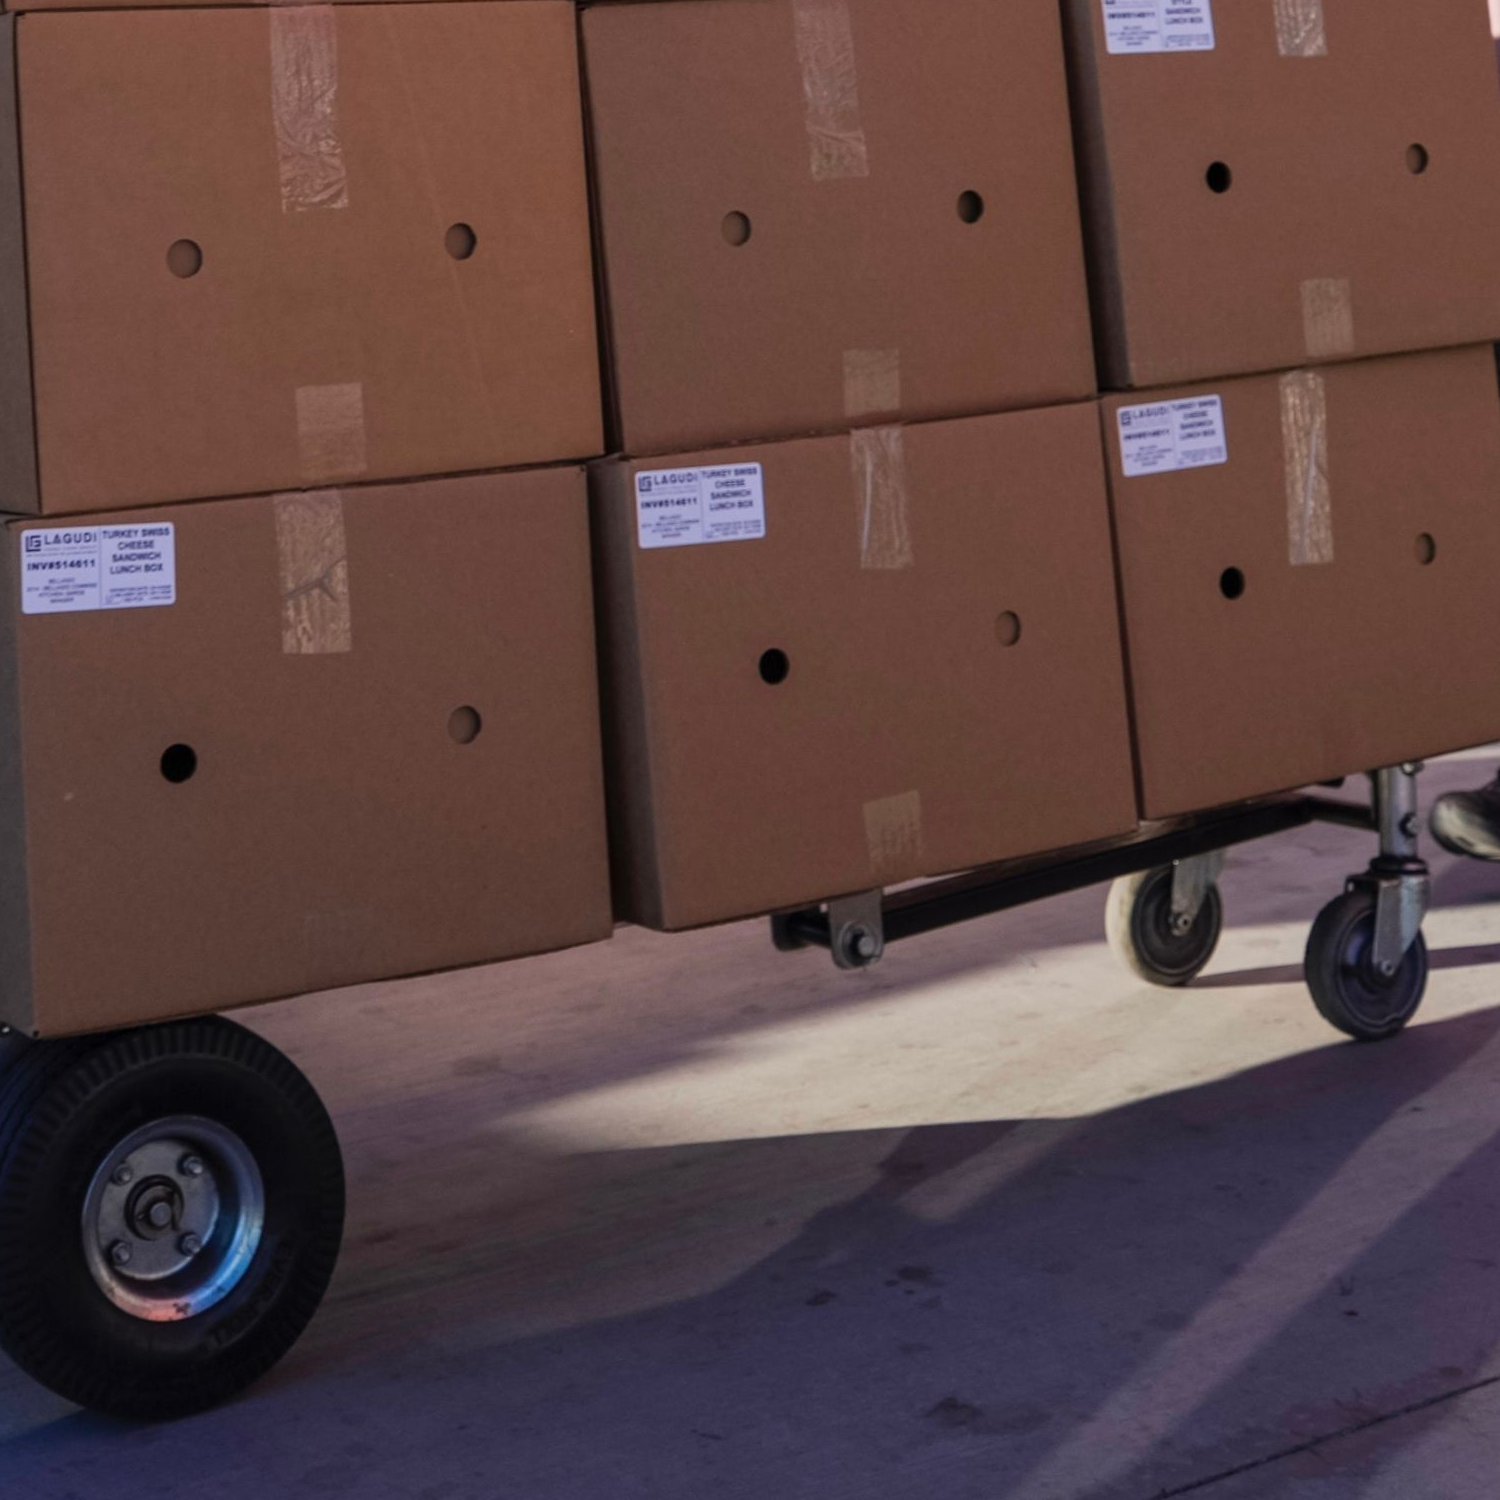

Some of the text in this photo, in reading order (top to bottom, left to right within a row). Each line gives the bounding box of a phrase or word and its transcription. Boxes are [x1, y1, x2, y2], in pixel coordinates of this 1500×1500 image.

[654, 472, 698, 485] LAGUDI
[44, 532, 97, 545] LAGUDI
[102, 526, 170, 540] TURKEY SWISS
[117, 540, 154, 550] CHEESE
[112, 551, 161, 563] SANDWICH
[110, 563, 164, 575] LUNCH BOX
